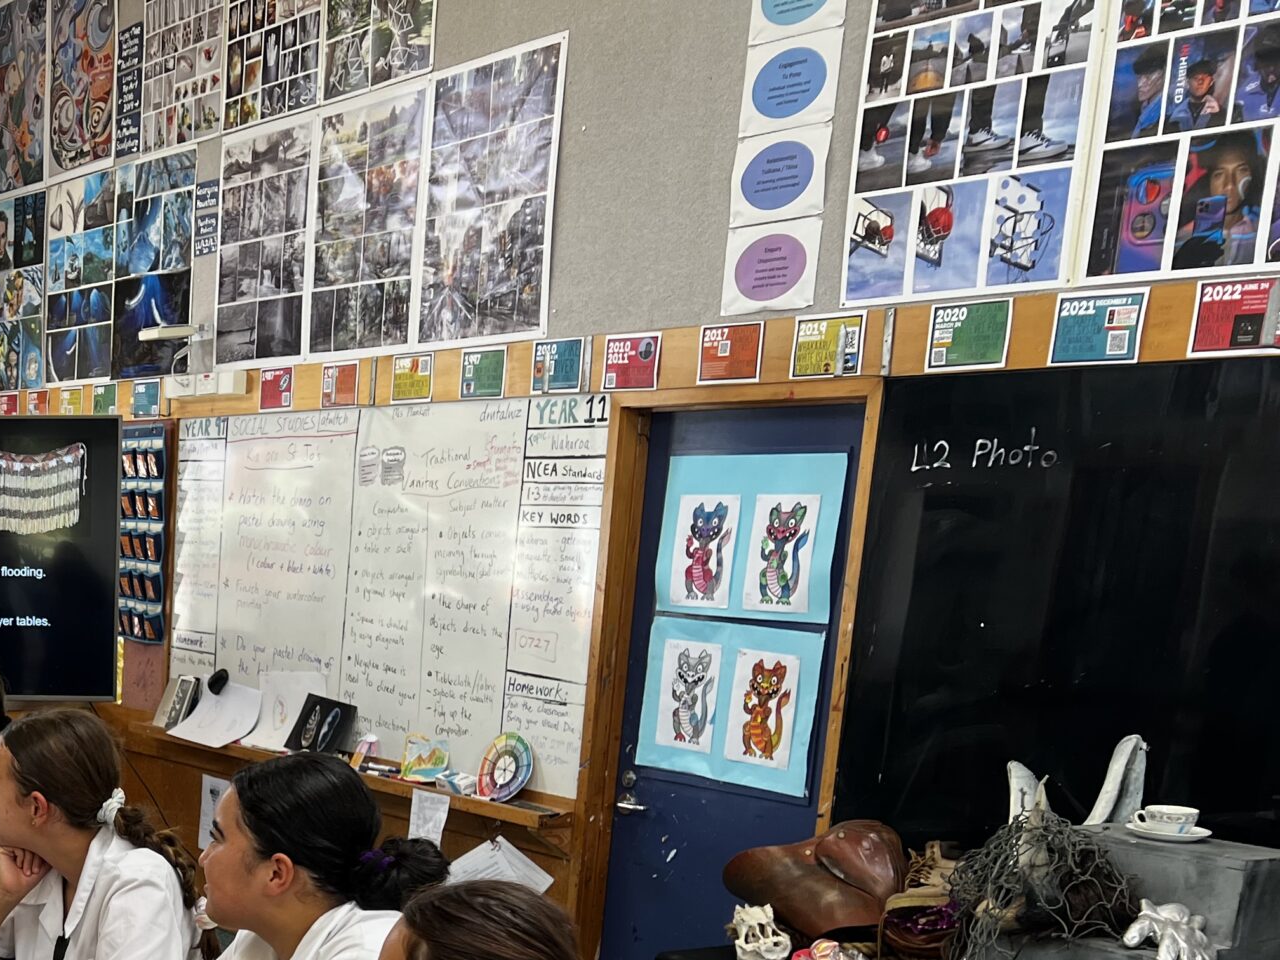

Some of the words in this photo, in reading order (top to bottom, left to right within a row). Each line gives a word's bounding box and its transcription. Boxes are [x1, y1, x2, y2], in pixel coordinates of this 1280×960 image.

[1202, 283, 1242, 303] 2022
[935, 306, 968, 324] 2020
[1060, 299, 1097, 317] 2021
[703, 328, 729, 342] 2017
[799, 321, 828, 336] 2019
[608, 341, 631, 354] 2010
[607, 352, 629, 365] 2011
[536, 397, 579, 425] YEAR
[583, 394, 608, 424] 11
[185, 418, 212, 438] YEAR
[231, 415, 269, 437] SOCIAL
[276, 414, 316, 433] STUDIES
[551, 433, 591, 451] Waharoa
[909, 438, 953, 474] L2
[970, 426, 1059, 470] Photo
[421, 446, 472, 469] Traditional
[526, 461, 558, 480] NCEA
[402, 472, 440, 491] Vanitas
[448, 499, 478, 518] Subject
[521, 509, 544, 523] KEY
[550, 511, 588, 525] WORDS
[302, 519, 326, 537] using
[303, 540, 334, 558] colour
[0, 565, 47, 580] flooding.
[15, 615, 52, 628] tables.
[518, 634, 551, 653] 0727
[506, 675, 569, 702] Homework:
[374, 713, 411, 735] directional
